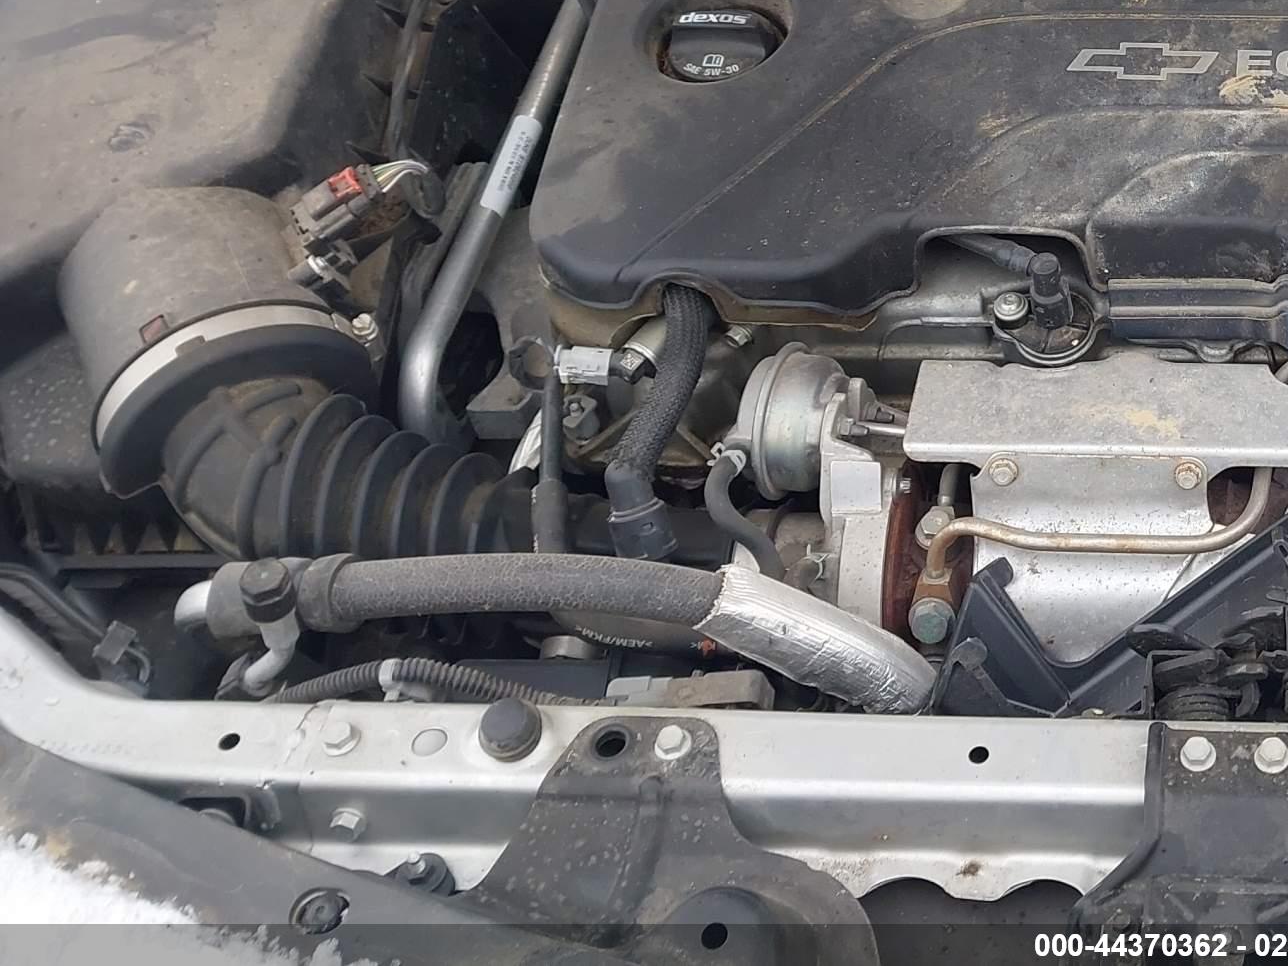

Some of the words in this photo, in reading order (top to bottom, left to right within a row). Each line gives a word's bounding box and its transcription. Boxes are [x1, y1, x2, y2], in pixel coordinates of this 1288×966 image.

[678, 12, 747, 25] dexos
[683, 62, 702, 75] SAE
[704, 64, 740, 76] 5W-30
